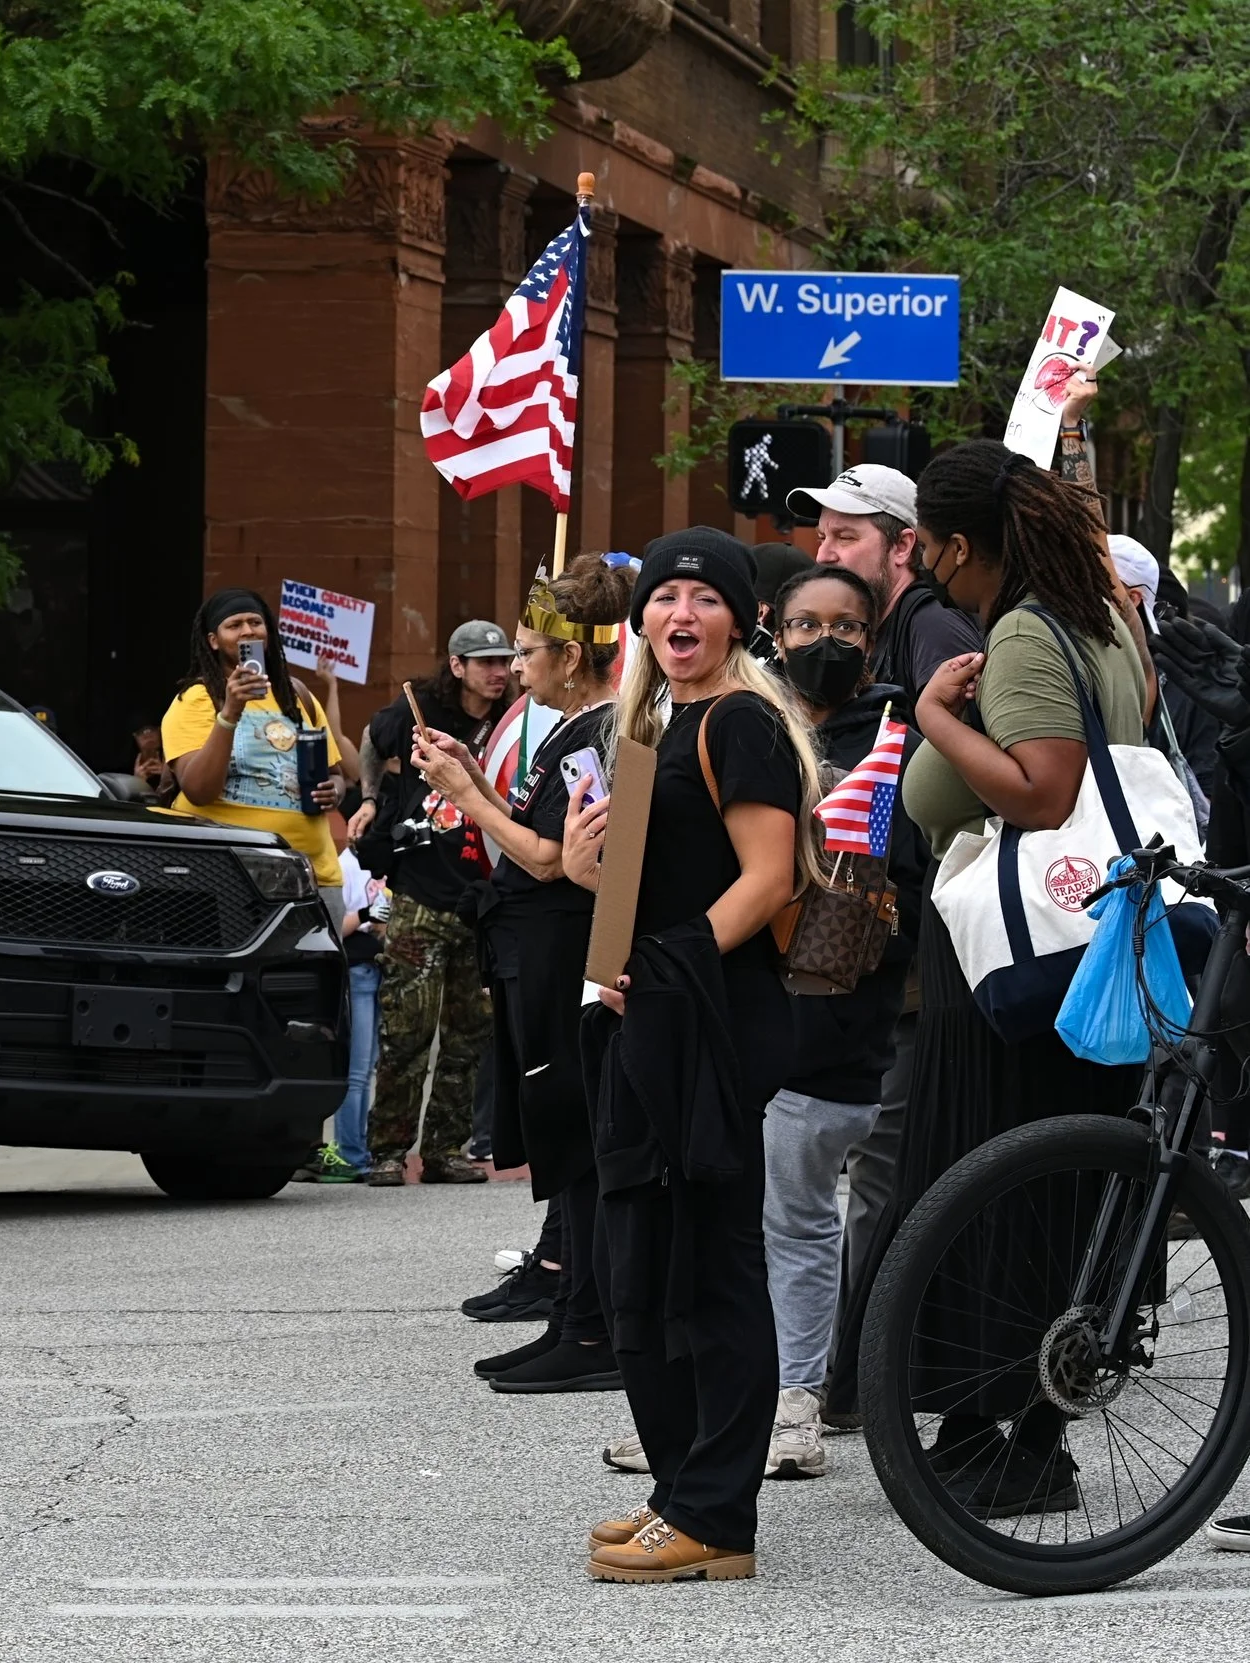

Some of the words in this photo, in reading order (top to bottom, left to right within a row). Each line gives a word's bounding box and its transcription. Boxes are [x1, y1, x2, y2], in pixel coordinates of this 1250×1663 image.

[736, 282, 784, 314] W.
[797, 283, 948, 322] Superior
[282, 594, 335, 619] BECOMES
[284, 581, 317, 599] WHEN
[321, 591, 367, 614] CRUELTY
[280, 607, 330, 632] NORMAL
[315, 645, 359, 668] RADICAL
[101, 875, 130, 890] Ford
[1053, 876, 1095, 897] TRADER
[1062, 888, 1093, 906] JOE'S
